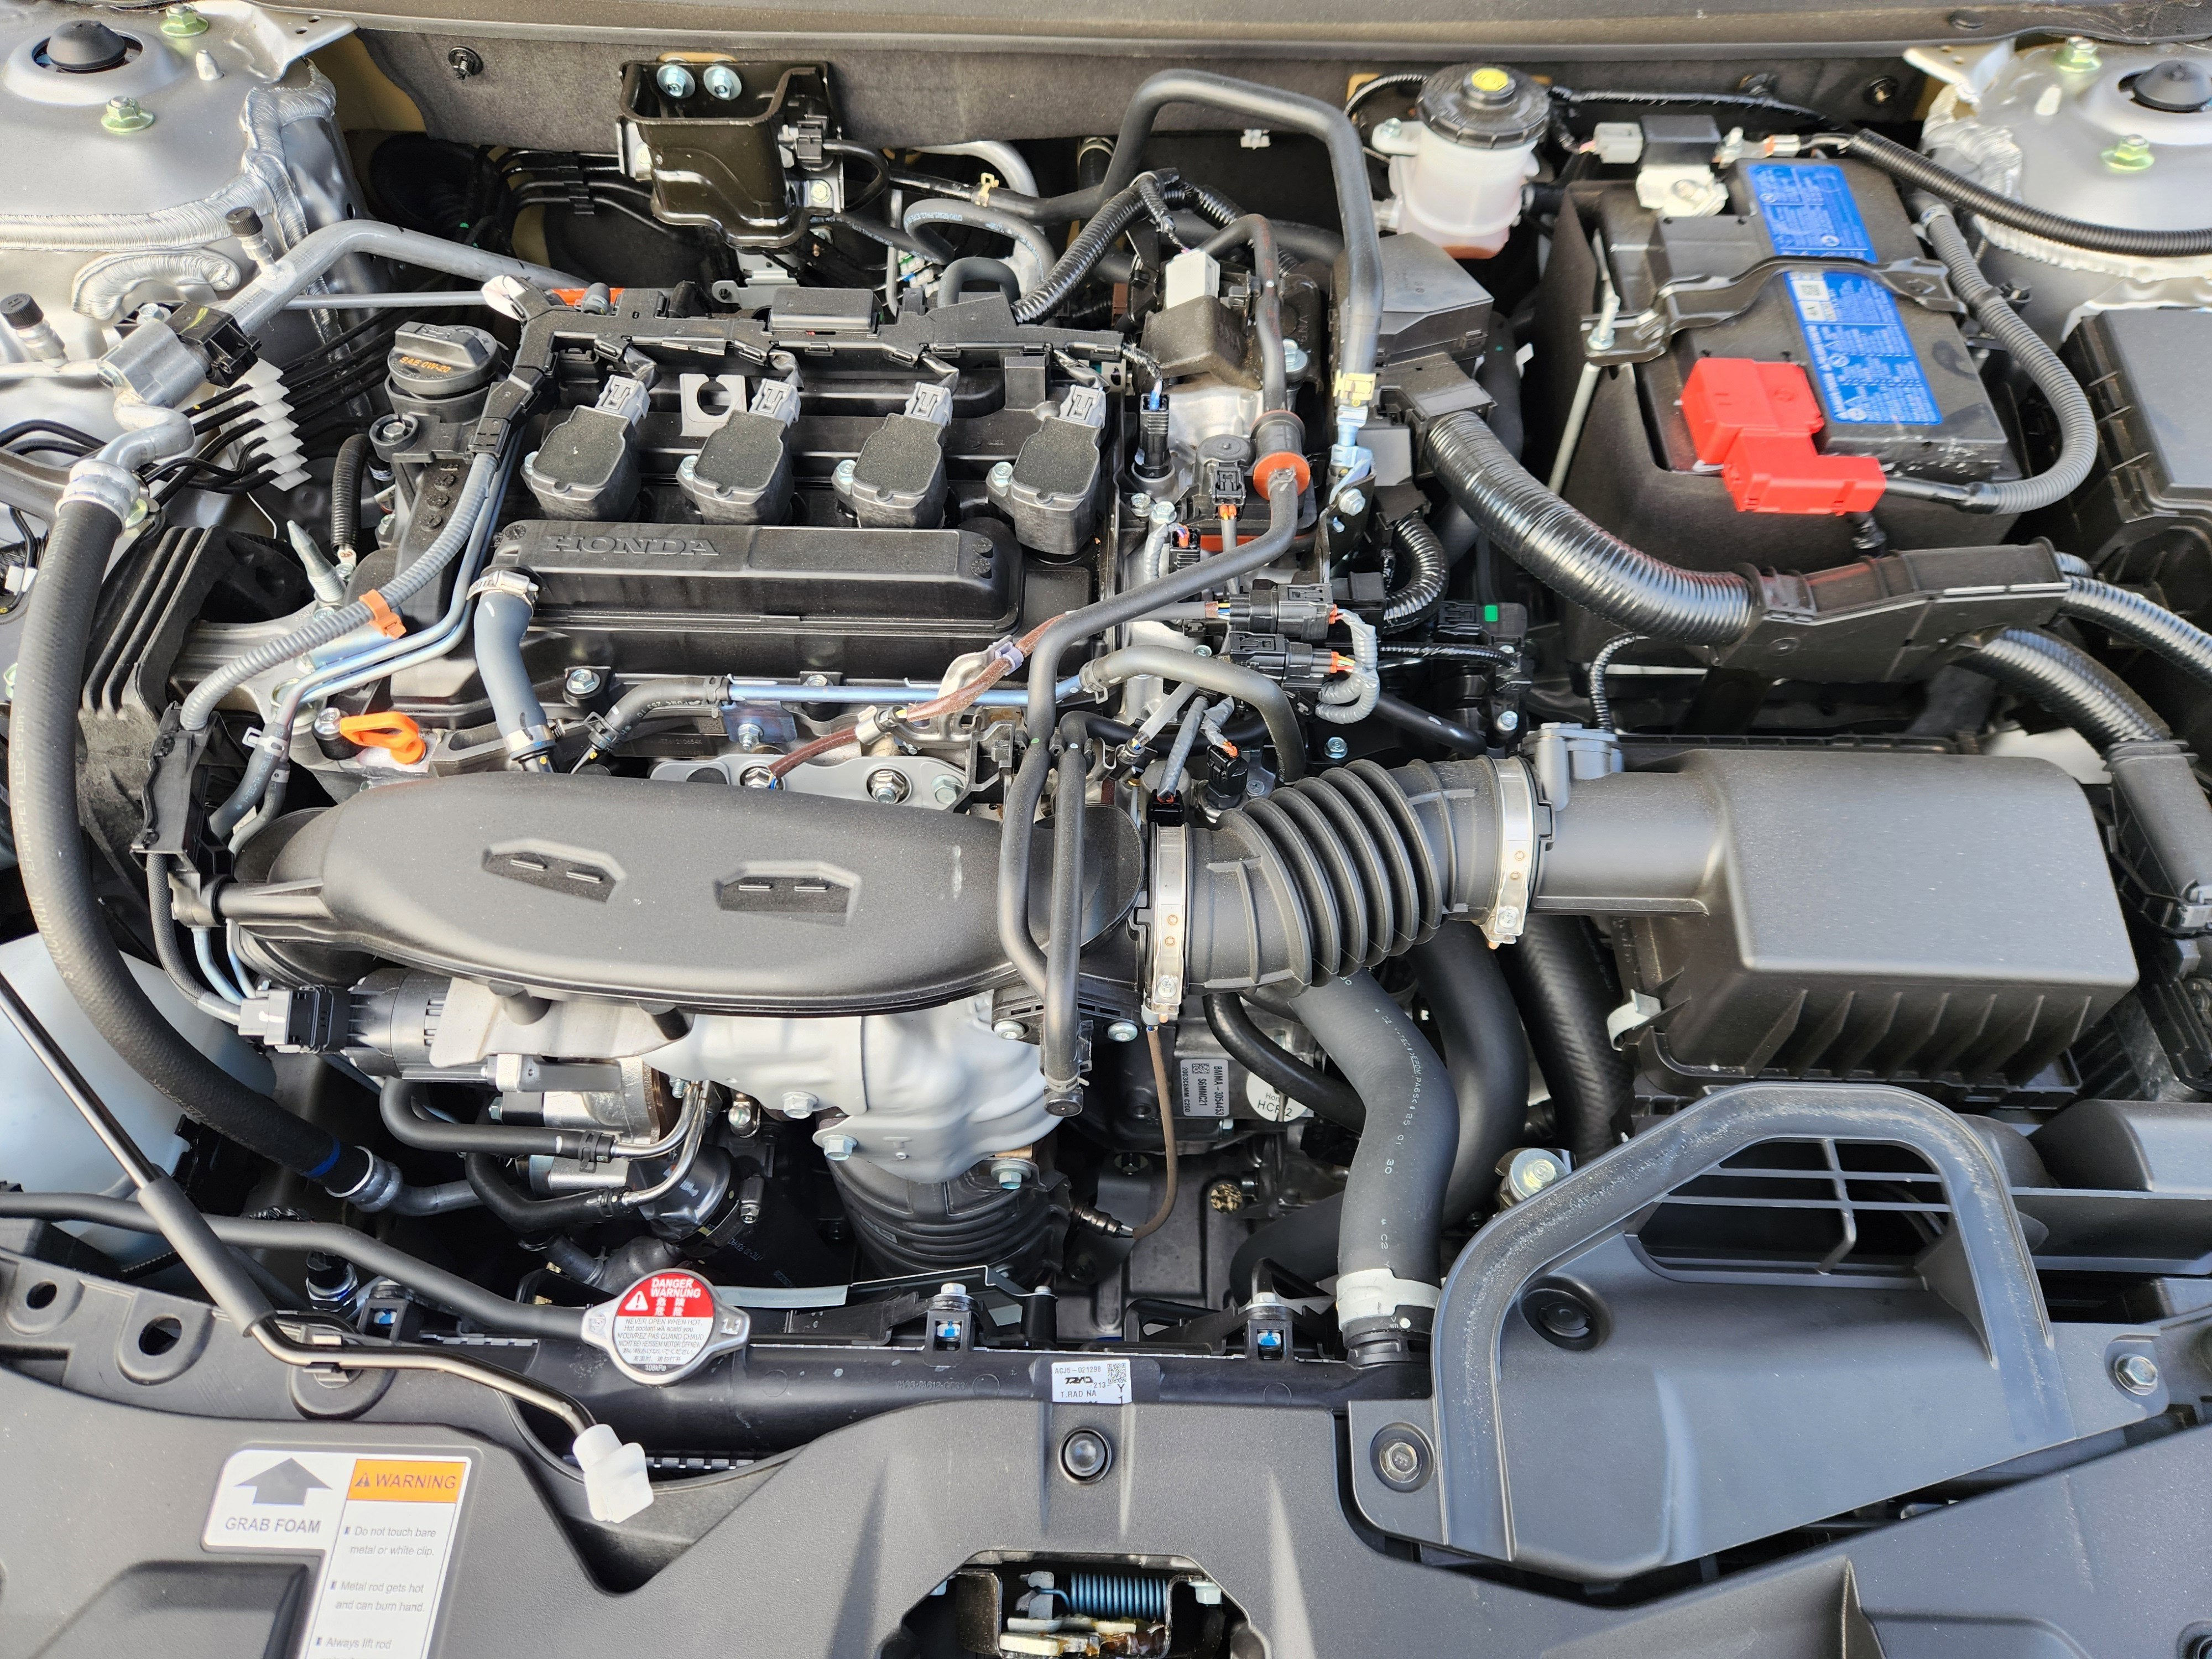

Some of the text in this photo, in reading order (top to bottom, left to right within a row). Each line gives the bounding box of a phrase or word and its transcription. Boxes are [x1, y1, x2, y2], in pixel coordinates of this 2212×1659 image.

[399, 356, 452, 373] SAE 0W-20
[543, 535, 719, 556] HONDA
[1198, 1078, 1208, 1106] S6MMC21
[1257, 1099, 1293, 1117] HCF2
[1384, 1158, 1395, 1175] 30
[651, 1277, 694, 1288] DANGER
[650, 1288, 702, 1298] WARNUNG
[1117, 1384, 1125, 1393] Y
[376, 1473, 457, 1489] WARNING
[226, 1517, 322, 1534] GRAB FOAM
[354, 1526, 436, 1538] Do not touch bare
[349, 1546, 375, 1554] metal
[390, 1546, 414, 1556] white
[416, 1547, 435, 1558] clip.
[341, 1581, 424, 1594] Metal rod gets hot
[335, 1600, 354, 1610] and
[375, 1601, 398, 1611] burn
[399, 1602, 425, 1613] hand.
[325, 1637, 393, 1650] Always lift rod
